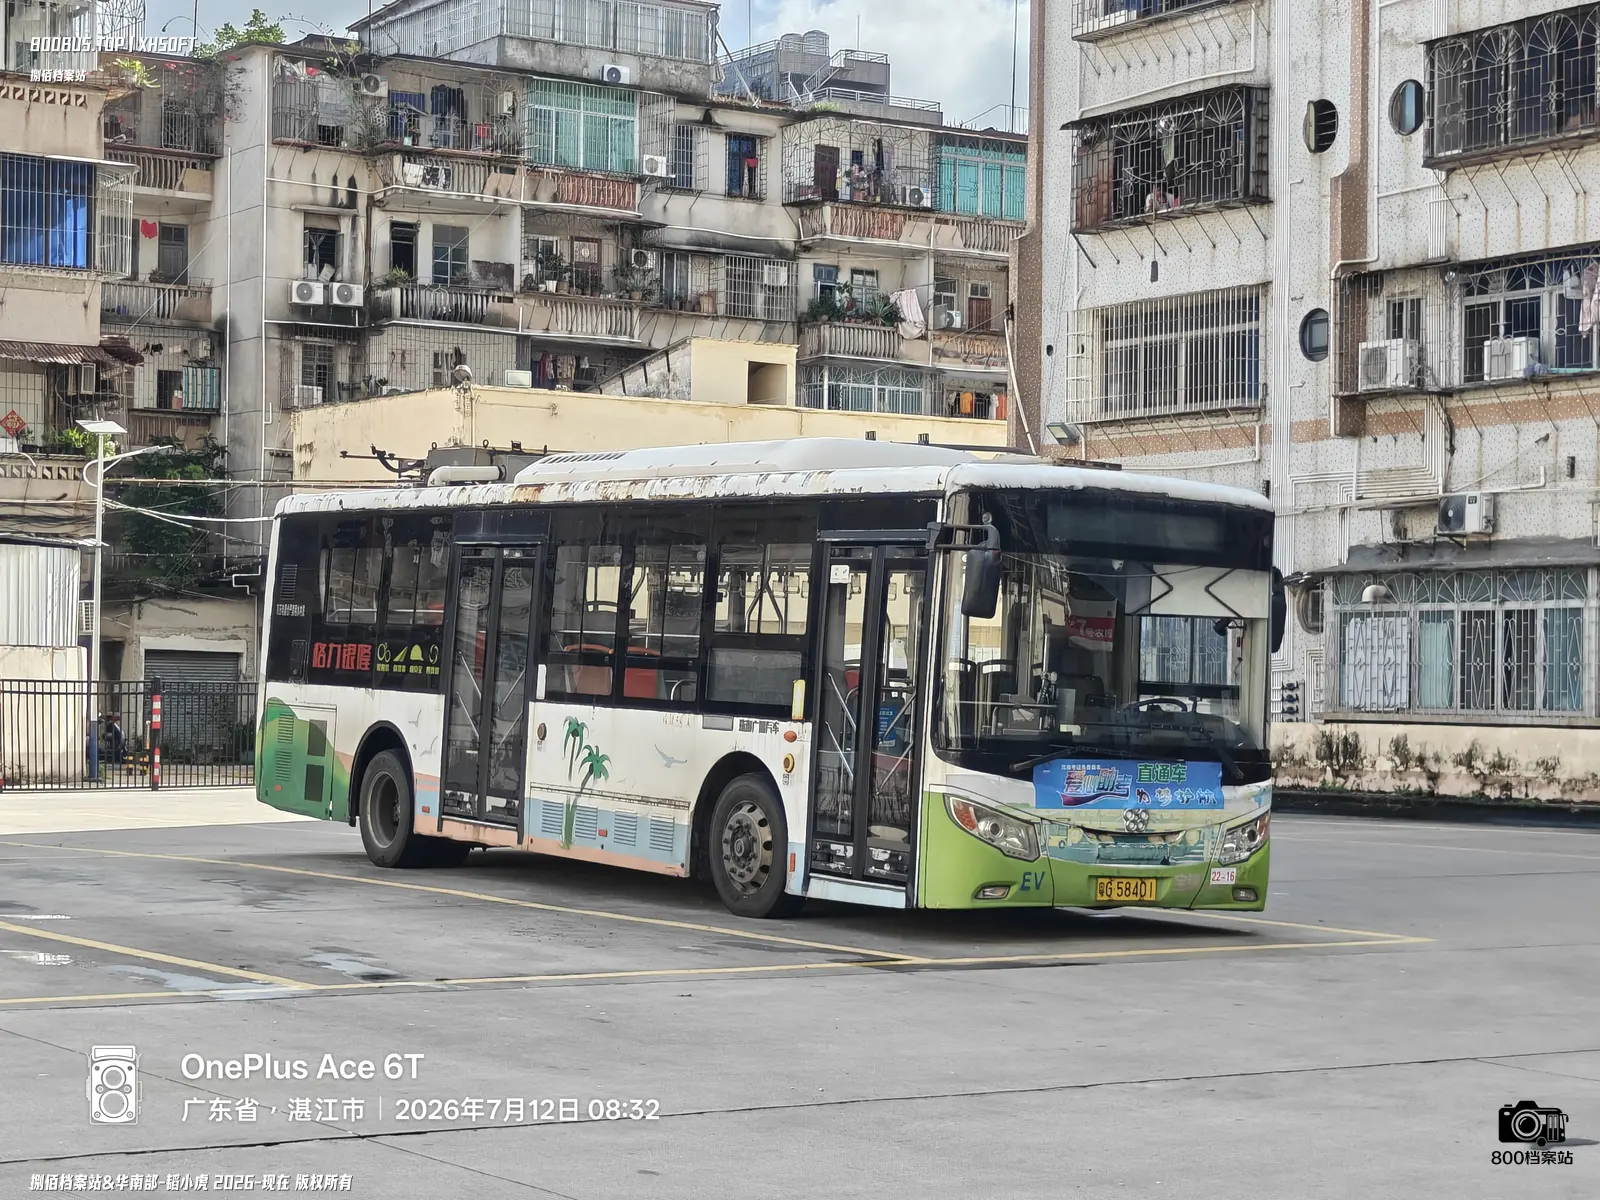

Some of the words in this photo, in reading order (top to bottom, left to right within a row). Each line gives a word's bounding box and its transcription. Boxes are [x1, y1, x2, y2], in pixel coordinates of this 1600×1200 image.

[1064, 766, 1133, 795] 爱心助考
[1136, 763, 1187, 784] 直通车
[1136, 787, 1218, 807] 为梦护航
[1019, 871, 1045, 891] EV
[1211, 870, 1235, 882] 22-16
